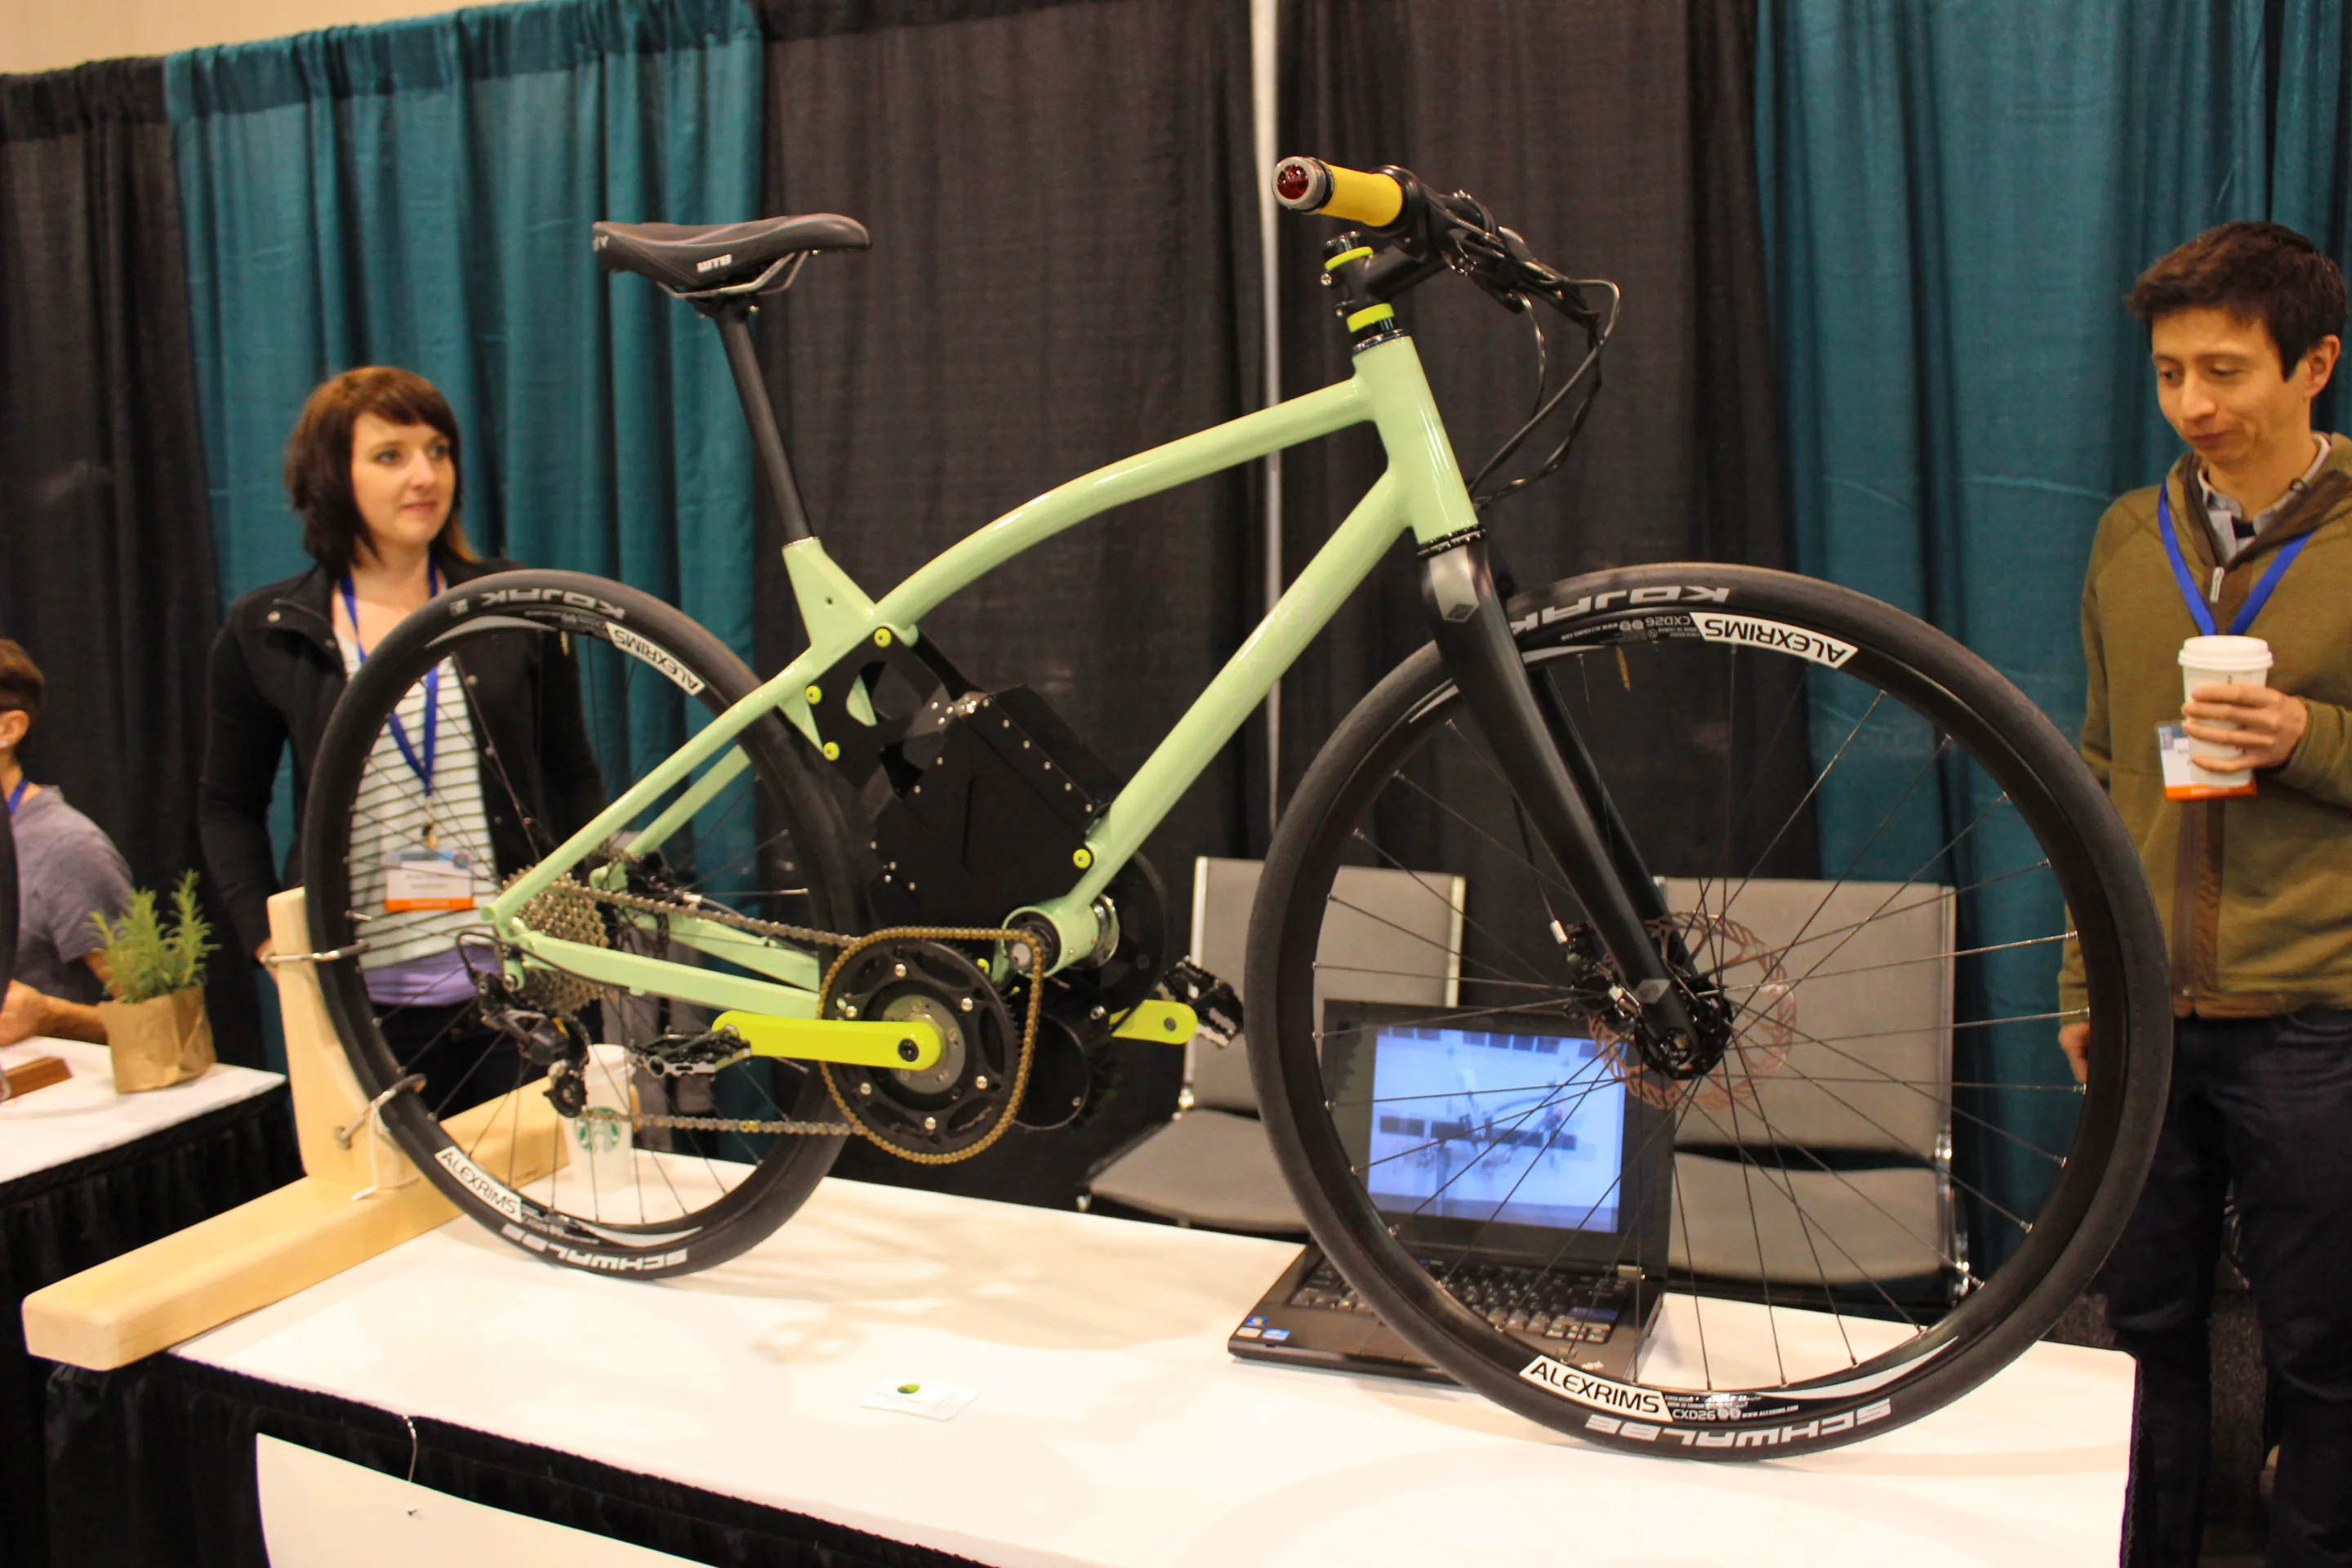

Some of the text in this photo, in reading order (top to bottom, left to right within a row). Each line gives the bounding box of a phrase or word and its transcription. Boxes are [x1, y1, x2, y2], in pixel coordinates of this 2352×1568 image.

[697, 253, 732, 273] WTB
[481, 588, 626, 619] KOJAK
[1645, 615, 1690, 628] CXD26
[613, 629, 700, 694] ALEXRIMS
[1704, 618, 1850, 665] ALEXRIMS
[441, 1151, 518, 1215] ALEXRIMS
[1530, 1361, 1661, 1414] ALEXRIMS
[1584, 1396, 1892, 1448] SCHWALBE
[1672, 1409, 1716, 1421] CXD26
